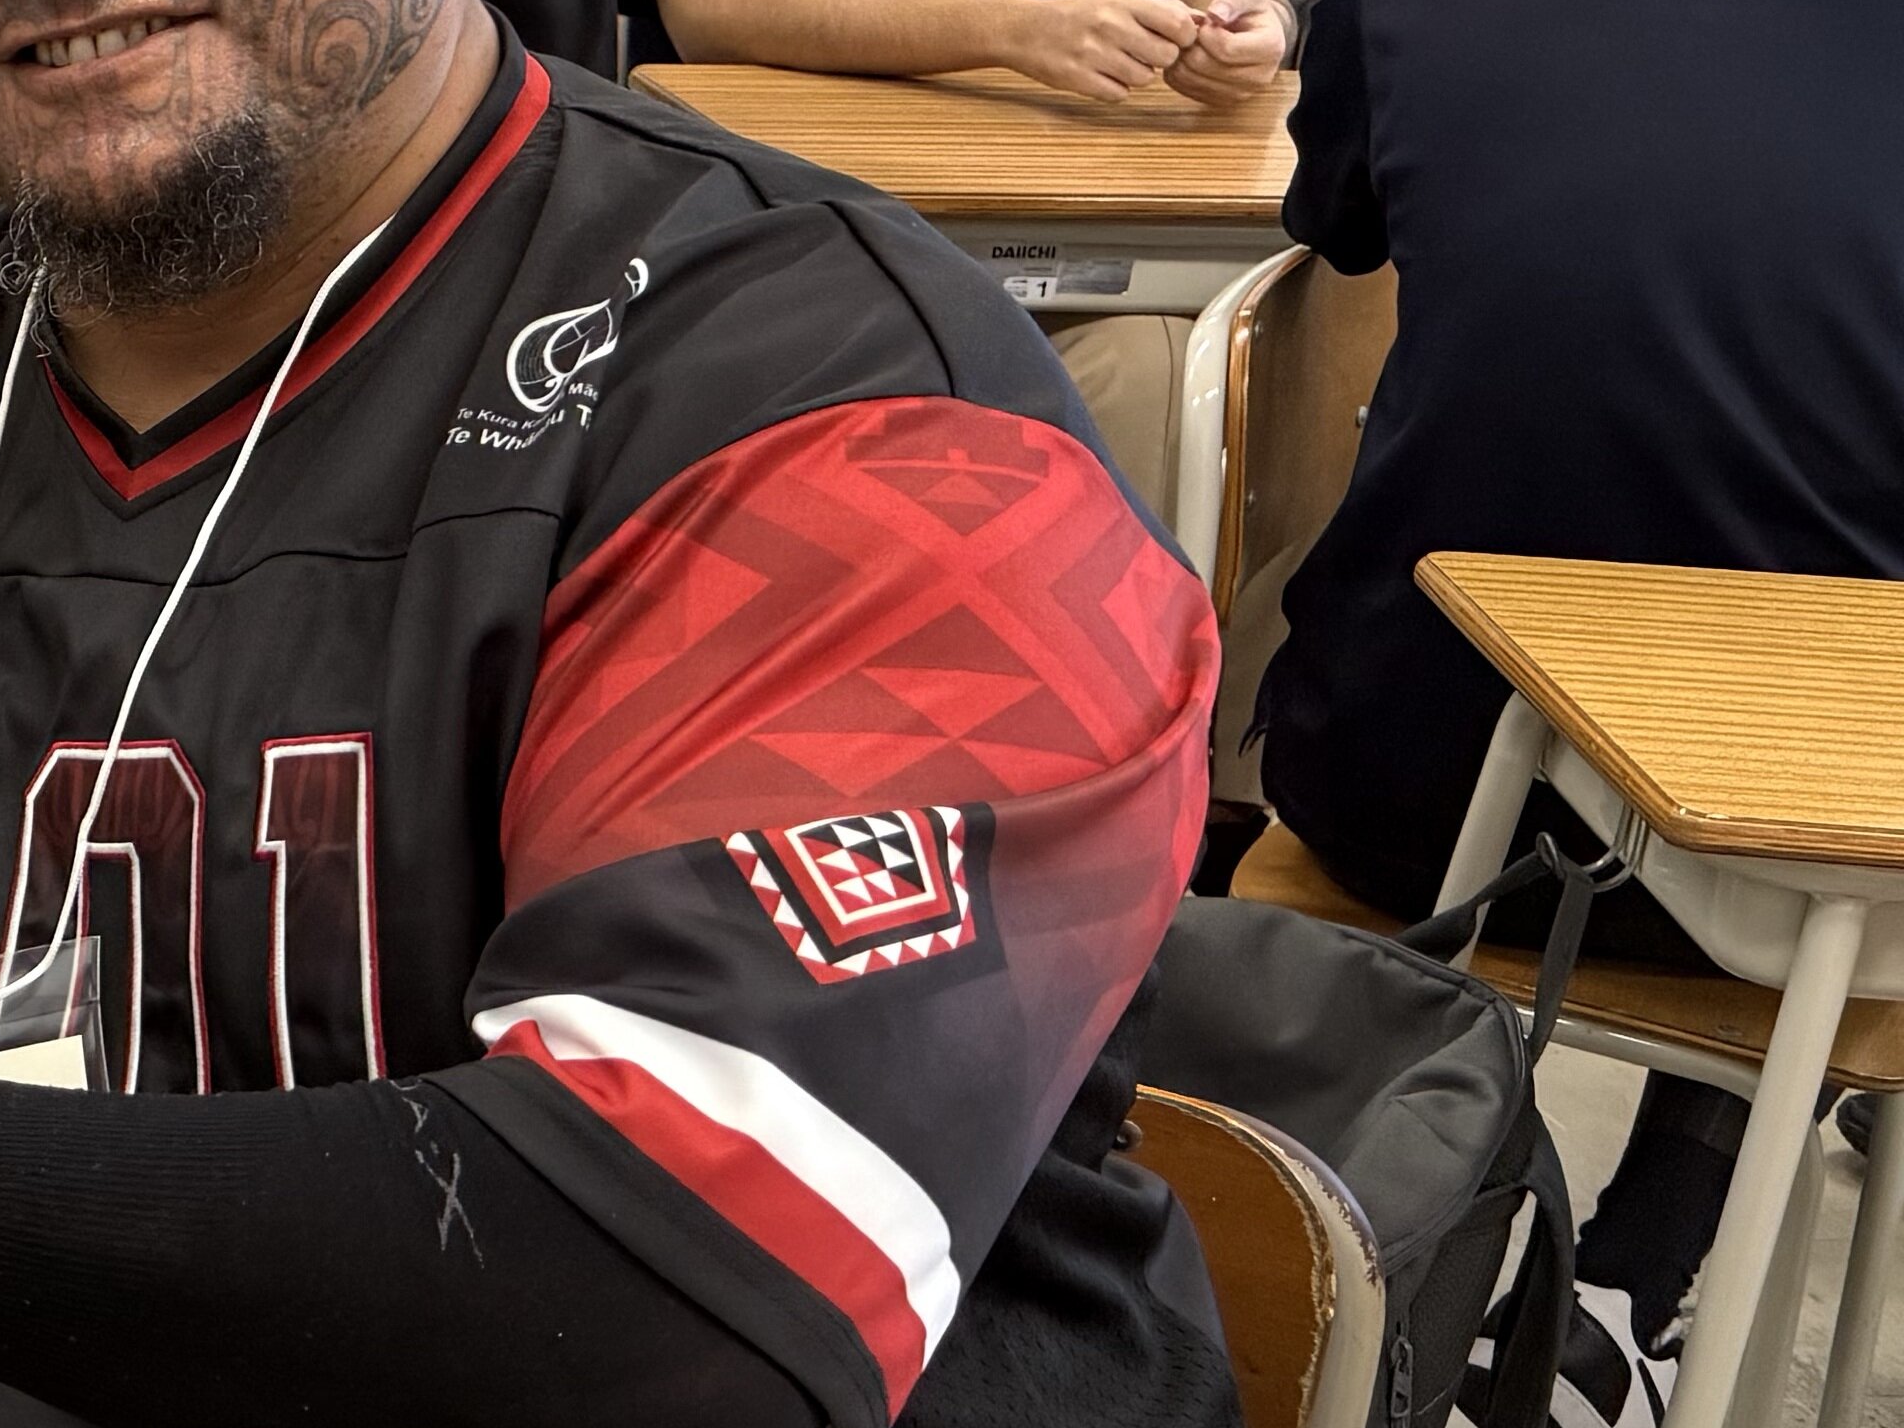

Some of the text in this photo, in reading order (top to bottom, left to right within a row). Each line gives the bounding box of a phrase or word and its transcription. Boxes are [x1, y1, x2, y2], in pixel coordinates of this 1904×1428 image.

[992, 245, 1057, 260] DAIICHI
[1036, 280, 1048, 299] 1
[476, 408, 518, 430] Kura
[444, 425, 472, 447] Te
